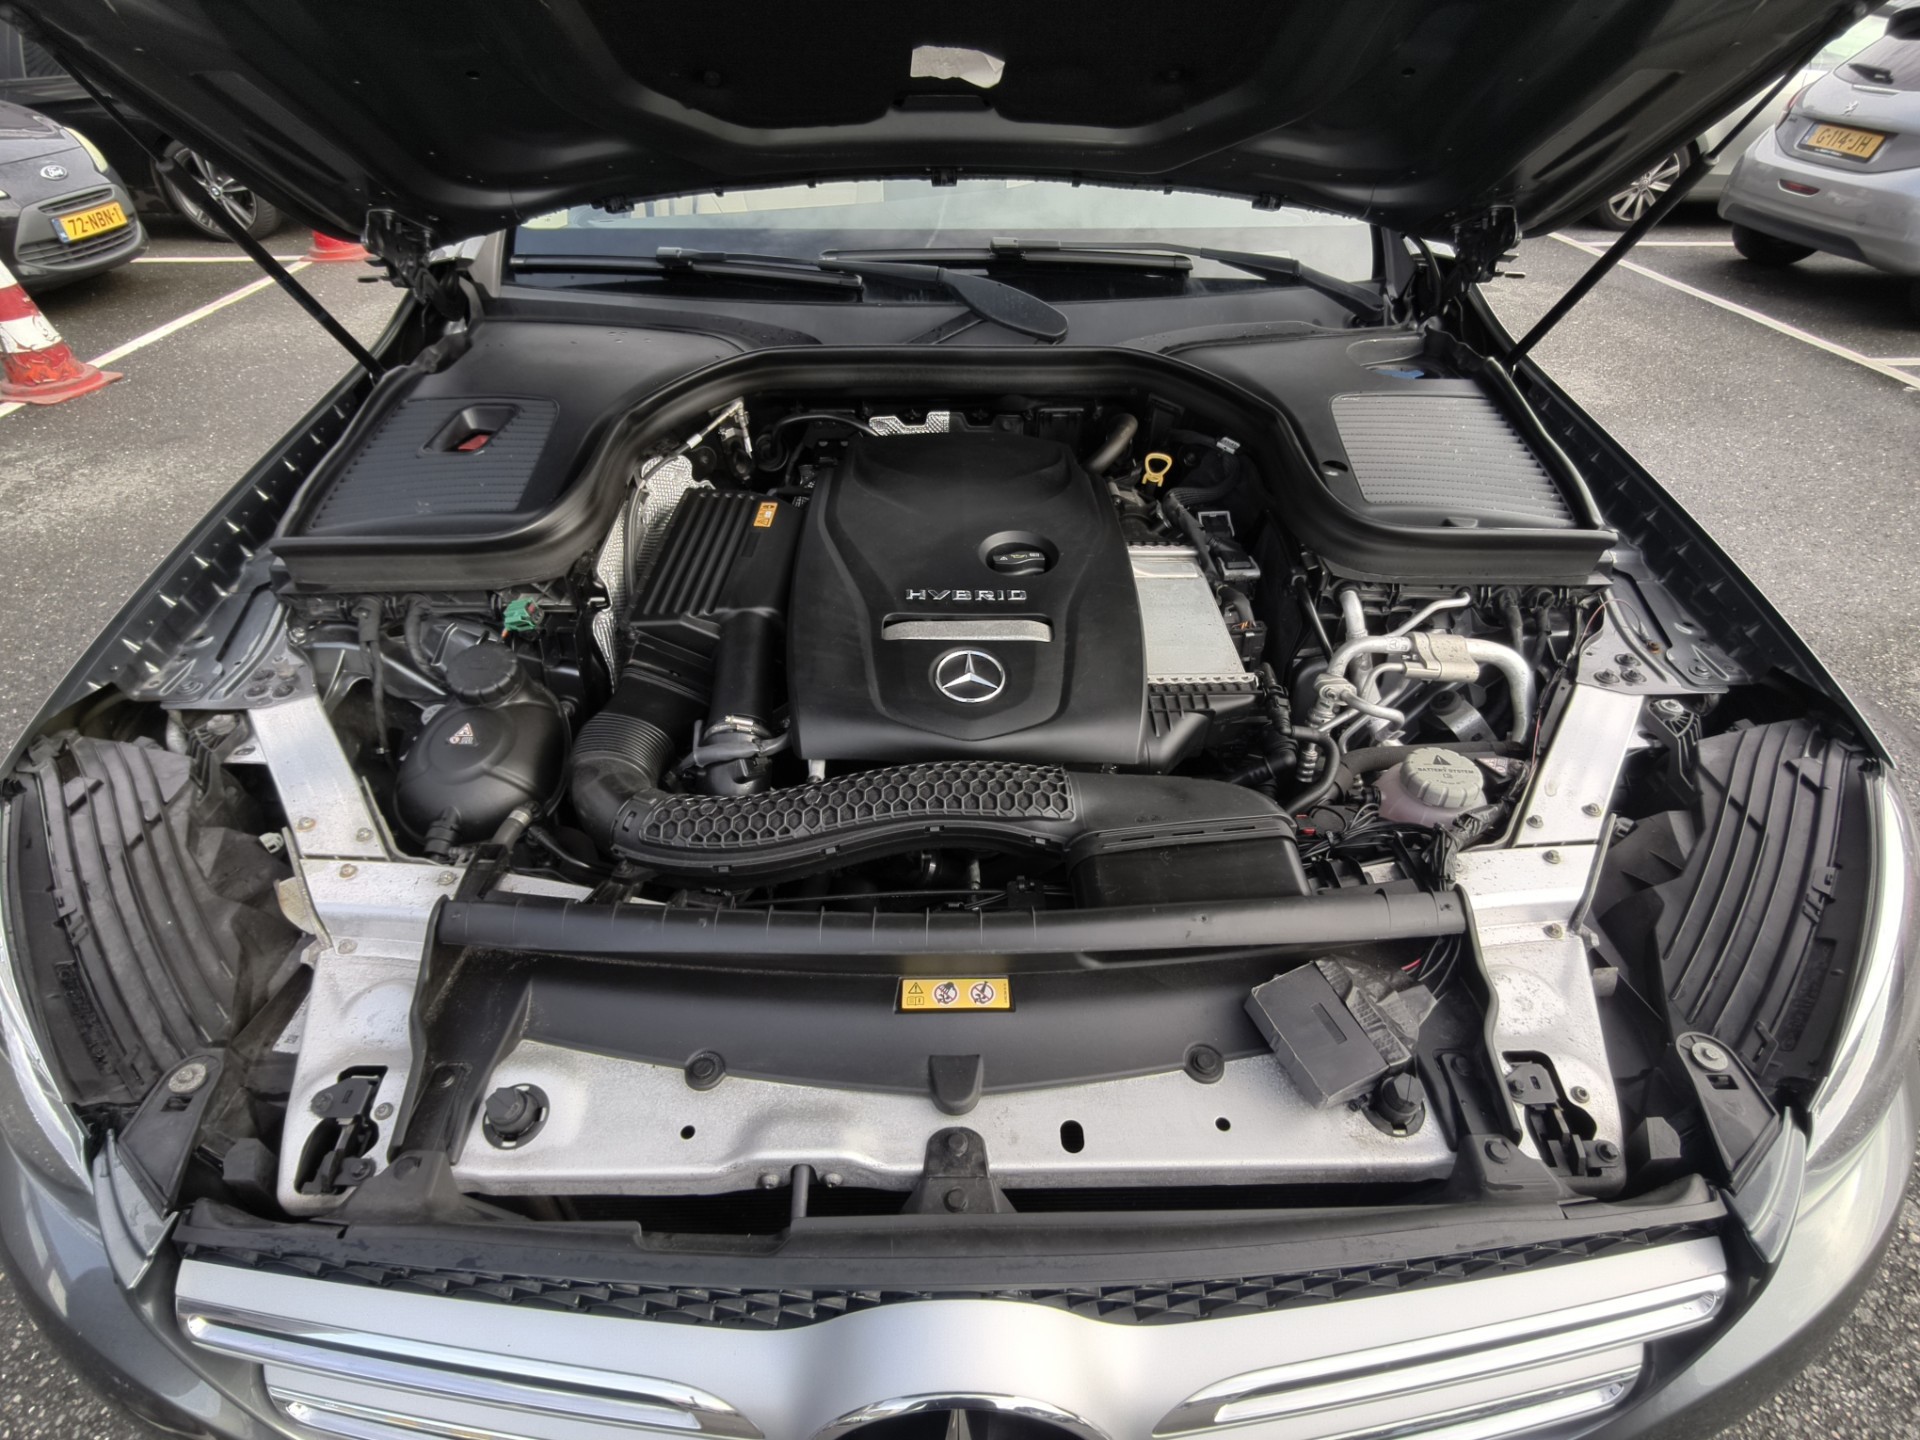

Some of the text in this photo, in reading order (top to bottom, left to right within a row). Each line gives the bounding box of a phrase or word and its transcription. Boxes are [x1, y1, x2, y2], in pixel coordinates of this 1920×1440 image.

[1816, 128, 1872, 153] G-114-JH
[68, 208, 121, 235] 72-NBN-1
[905, 589, 1027, 601] HYBRID
